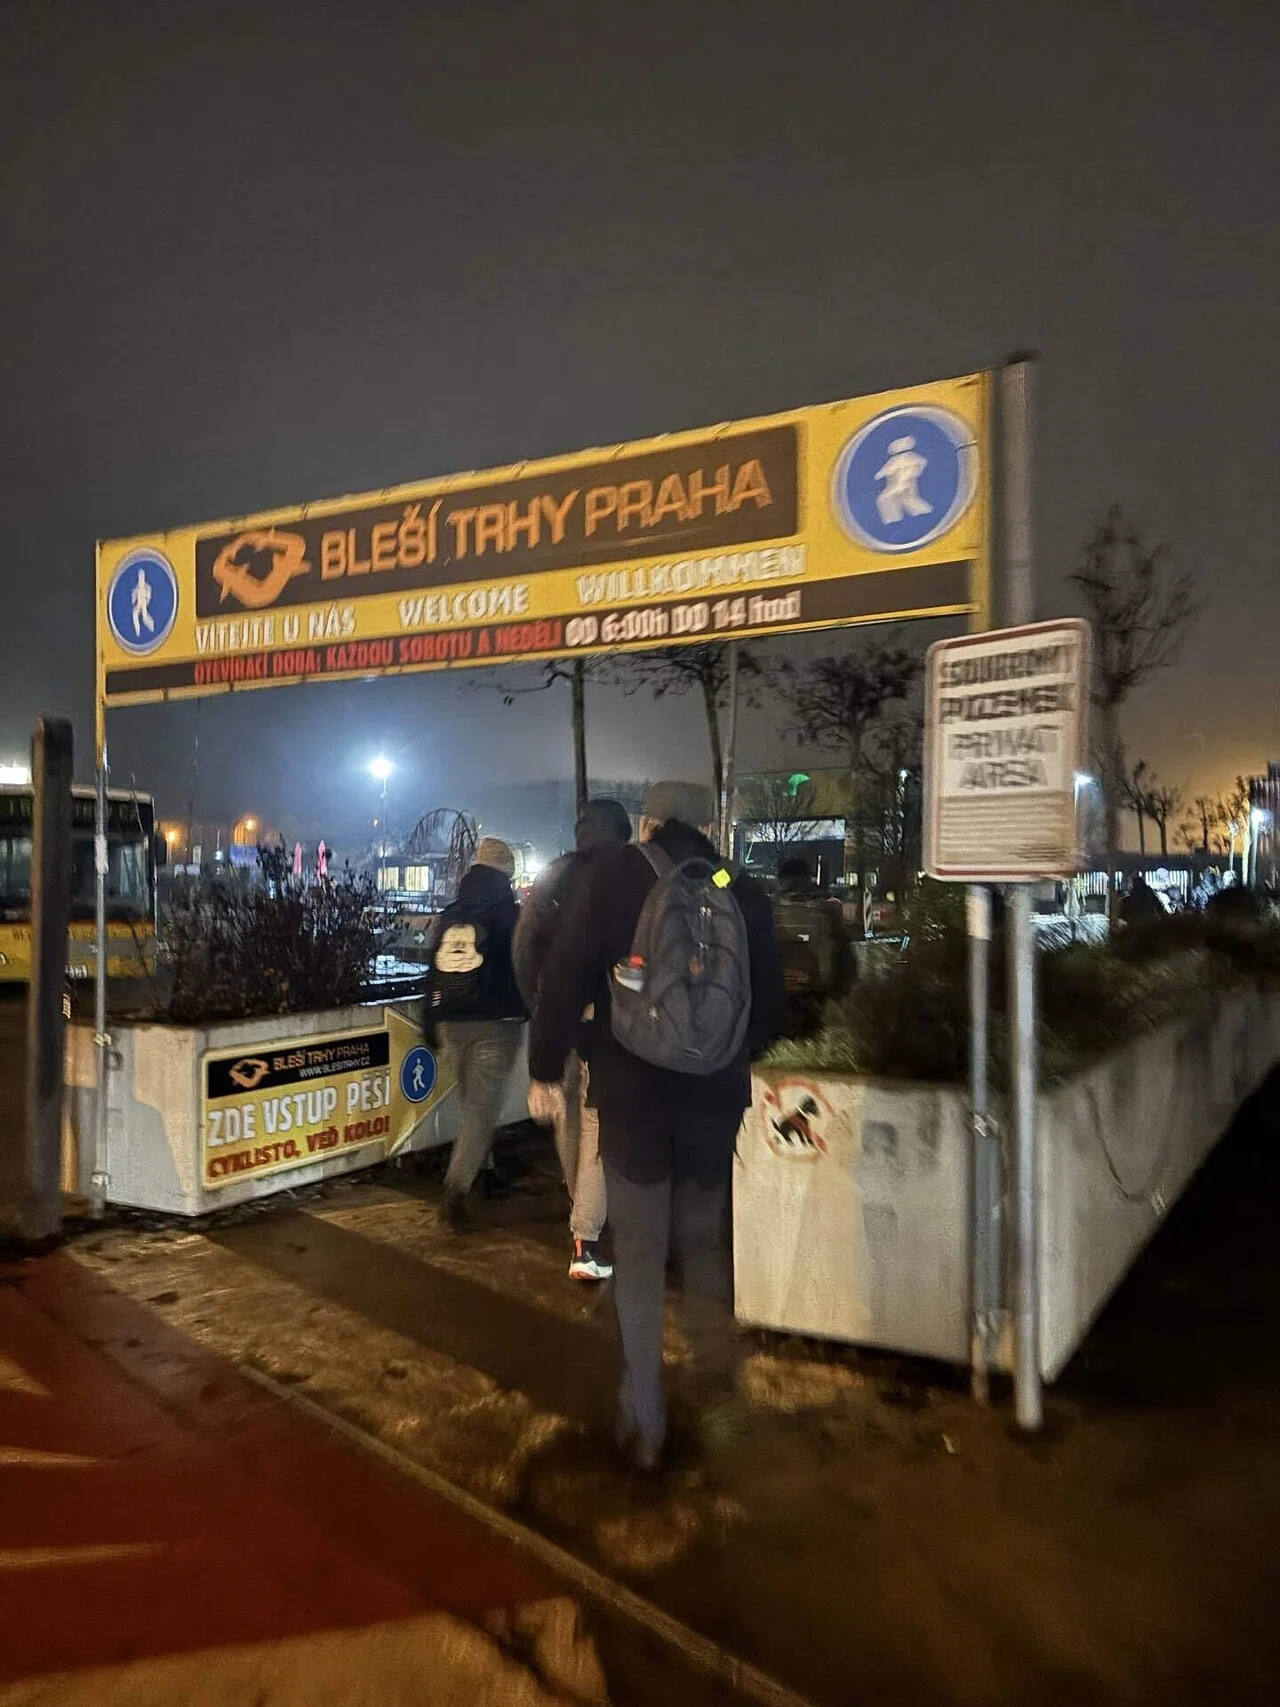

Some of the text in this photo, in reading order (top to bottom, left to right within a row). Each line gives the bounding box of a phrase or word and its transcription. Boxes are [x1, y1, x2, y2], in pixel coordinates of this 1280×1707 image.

[320, 459, 773, 581] BLEŠÍ TRHY PRAHA
[283, 611, 300, 644] U
[309, 603, 356, 641] NÁS
[398, 583, 529, 628] WELCOME
[575, 543, 807, 605] WILLKOMMEN
[399, 630, 472, 664] SOBOTU
[478, 627, 491, 655] A
[564, 615, 598, 647] OD
[671, 602, 709, 635] DO
[712, 597, 746, 630] 14
[307, 1048, 336, 1065] TRHY
[337, 1042, 370, 1059] PRAHA
[208, 1104, 256, 1147] ZDE
[262, 1087, 337, 1134] VSTUP
[306, 1125, 339, 1151] VEĎ
